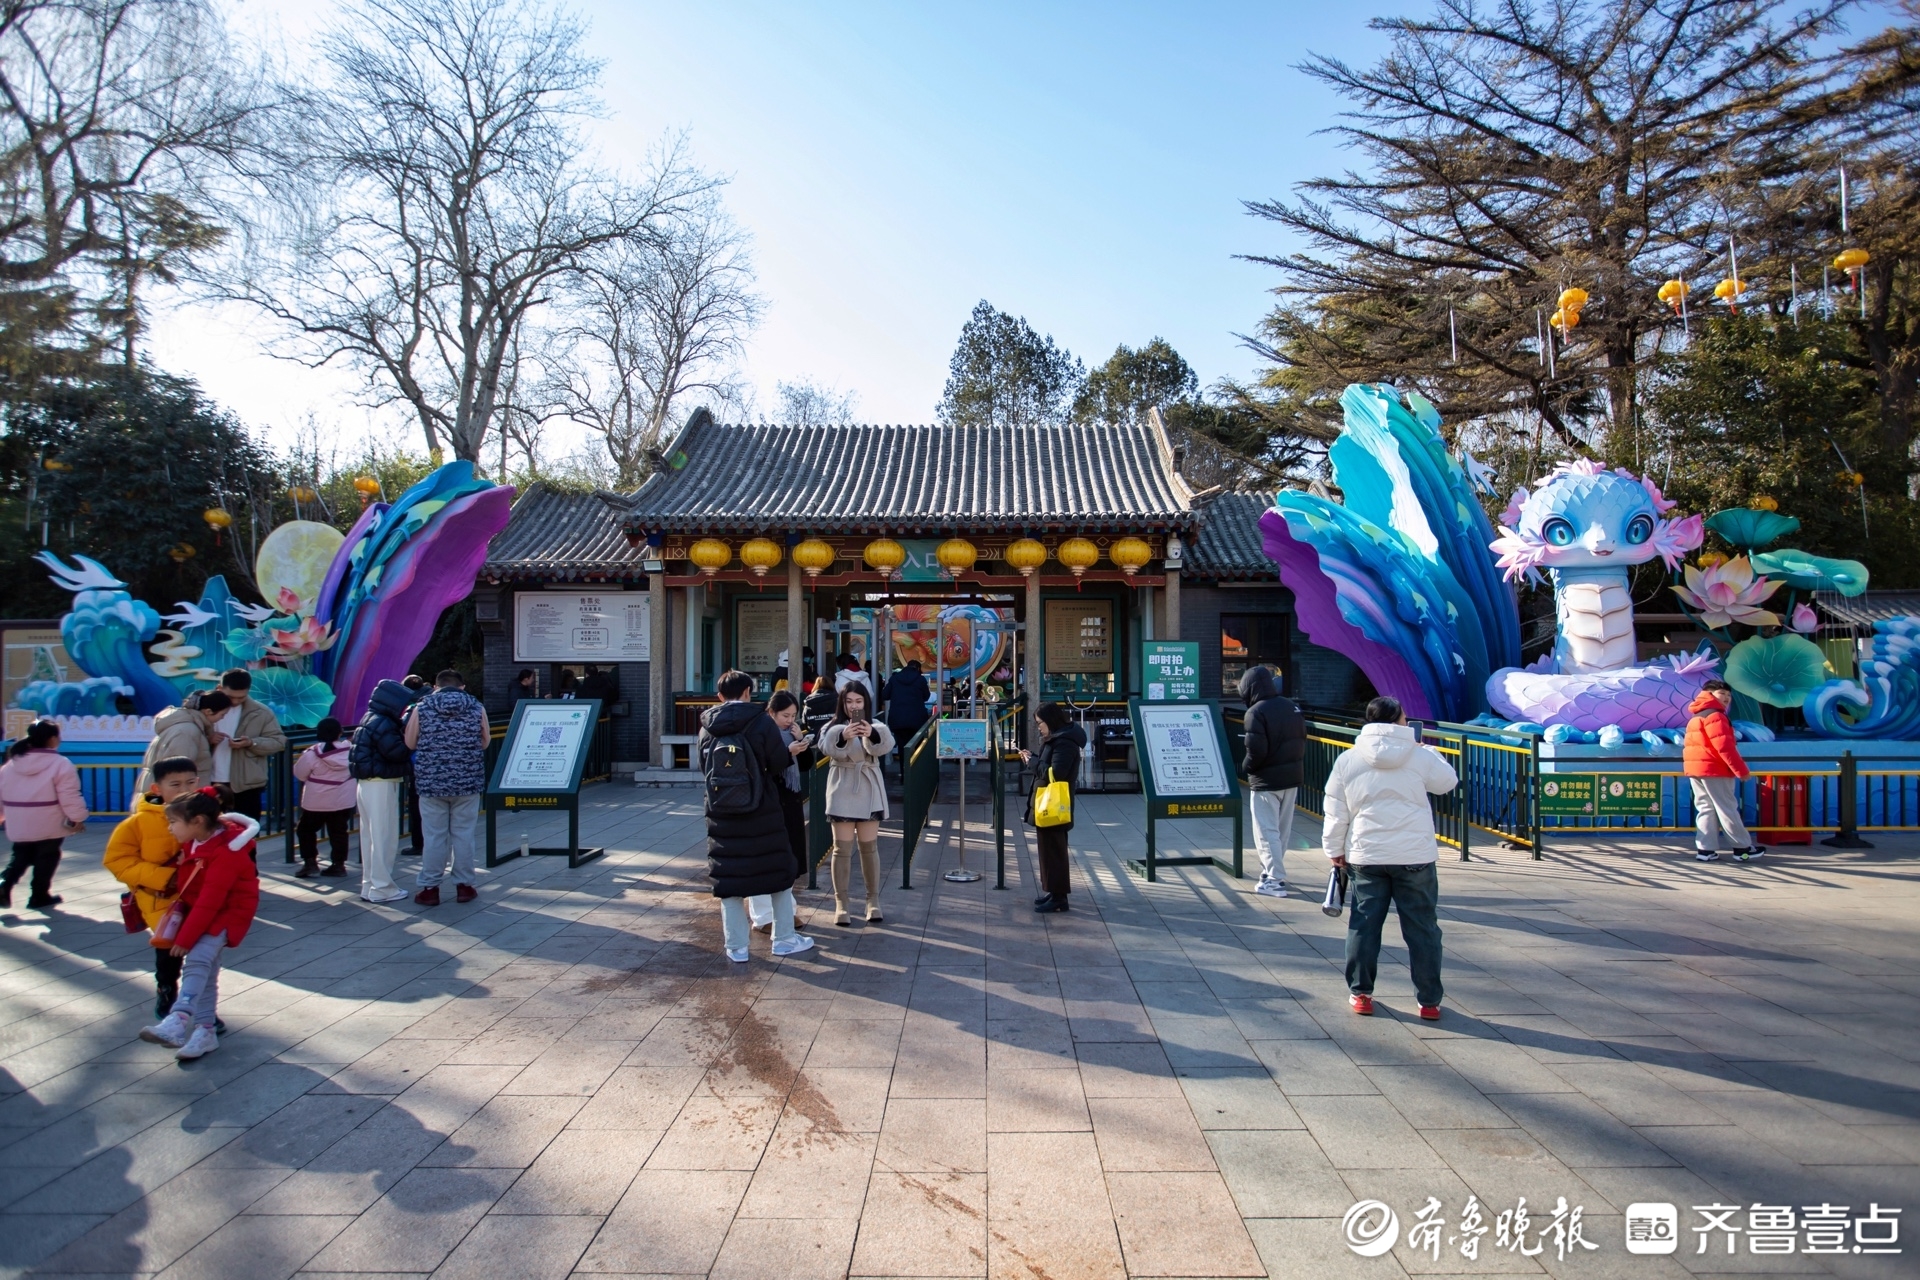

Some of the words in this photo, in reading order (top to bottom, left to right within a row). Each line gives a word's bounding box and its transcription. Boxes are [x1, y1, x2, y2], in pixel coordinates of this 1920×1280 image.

[903, 551, 939, 568] 入口
[1149, 655, 1183, 665] 即时拍
[1160, 666, 1195, 676] 马上办
[1560, 781, 1591, 789] 请勿翻越
[1626, 781, 1656, 789] 有电危险
[1560, 791, 1590, 799] 注意安全
[1626, 791, 1656, 799] 注意安全
